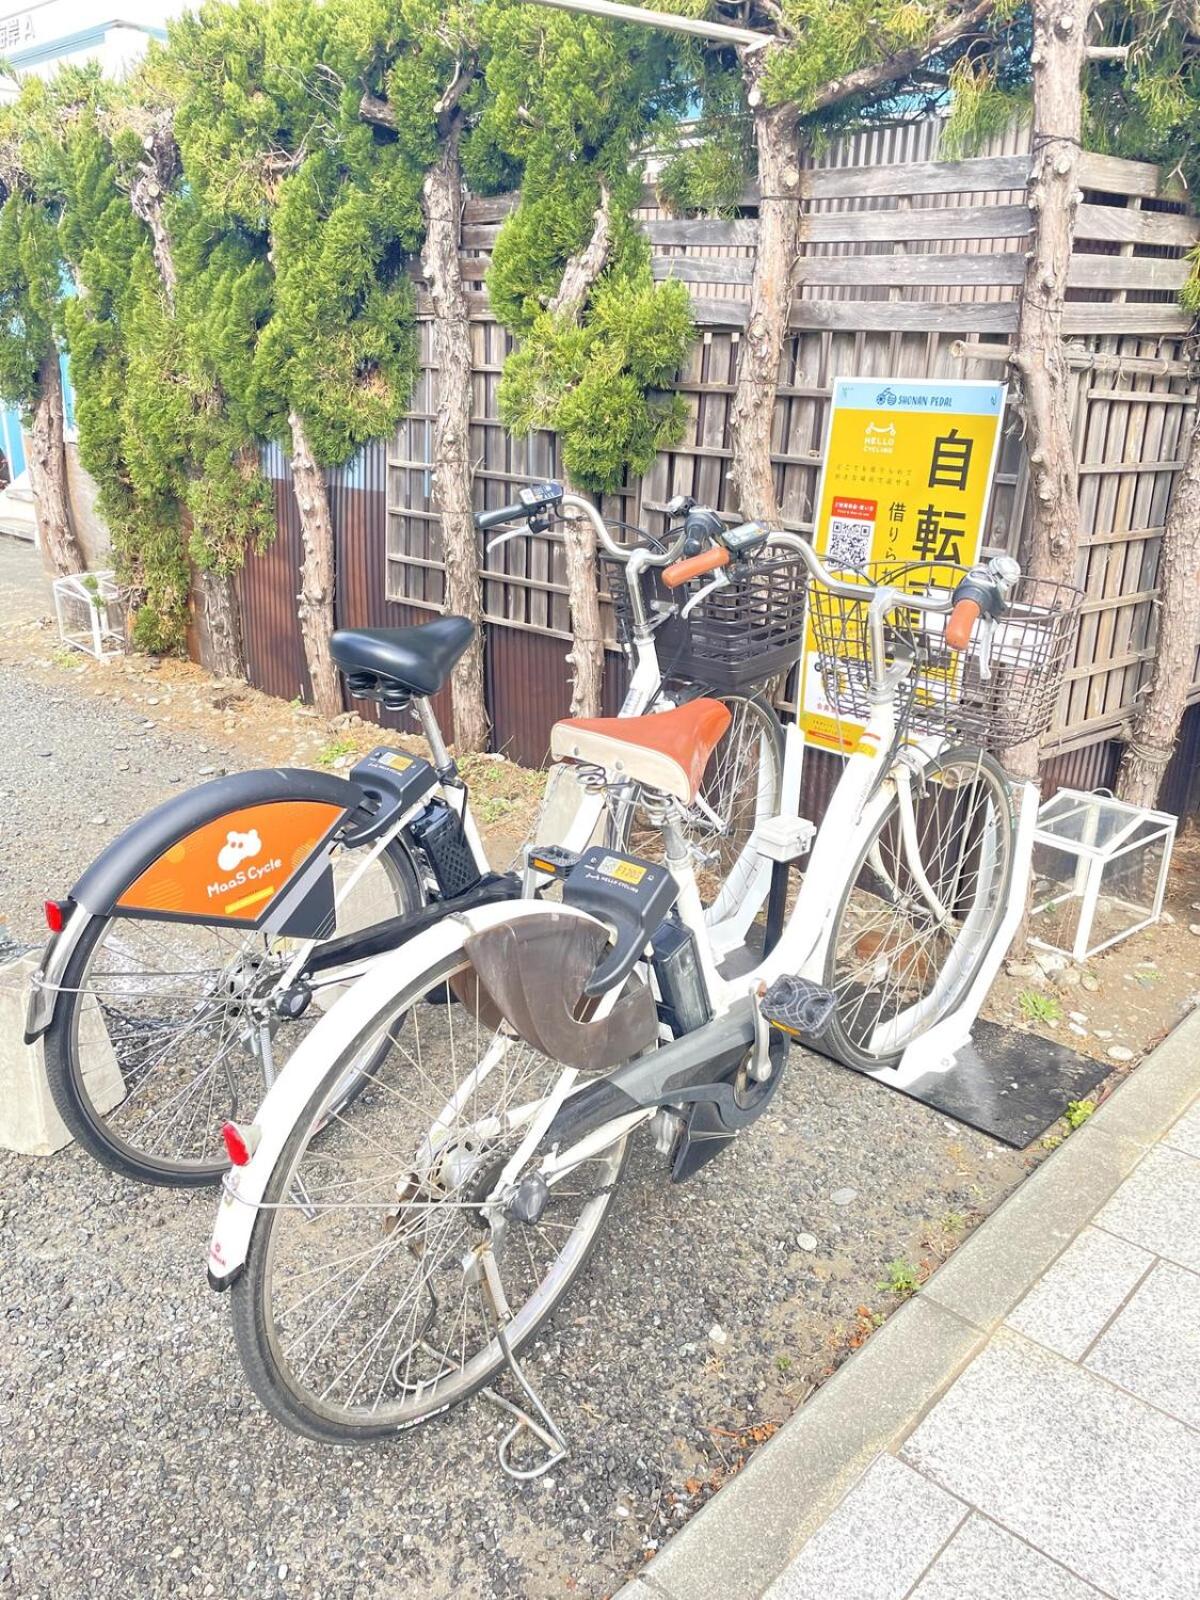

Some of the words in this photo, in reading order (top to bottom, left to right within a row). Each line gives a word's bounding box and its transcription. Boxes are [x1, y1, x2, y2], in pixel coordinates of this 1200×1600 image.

[898, 394, 928, 406] SHONAN
[930, 396, 953, 407] PEDAL
[864, 436, 896, 446] HELLO
[207, 871, 247, 898] MaaS
[247, 858, 283, 880] Cycle
